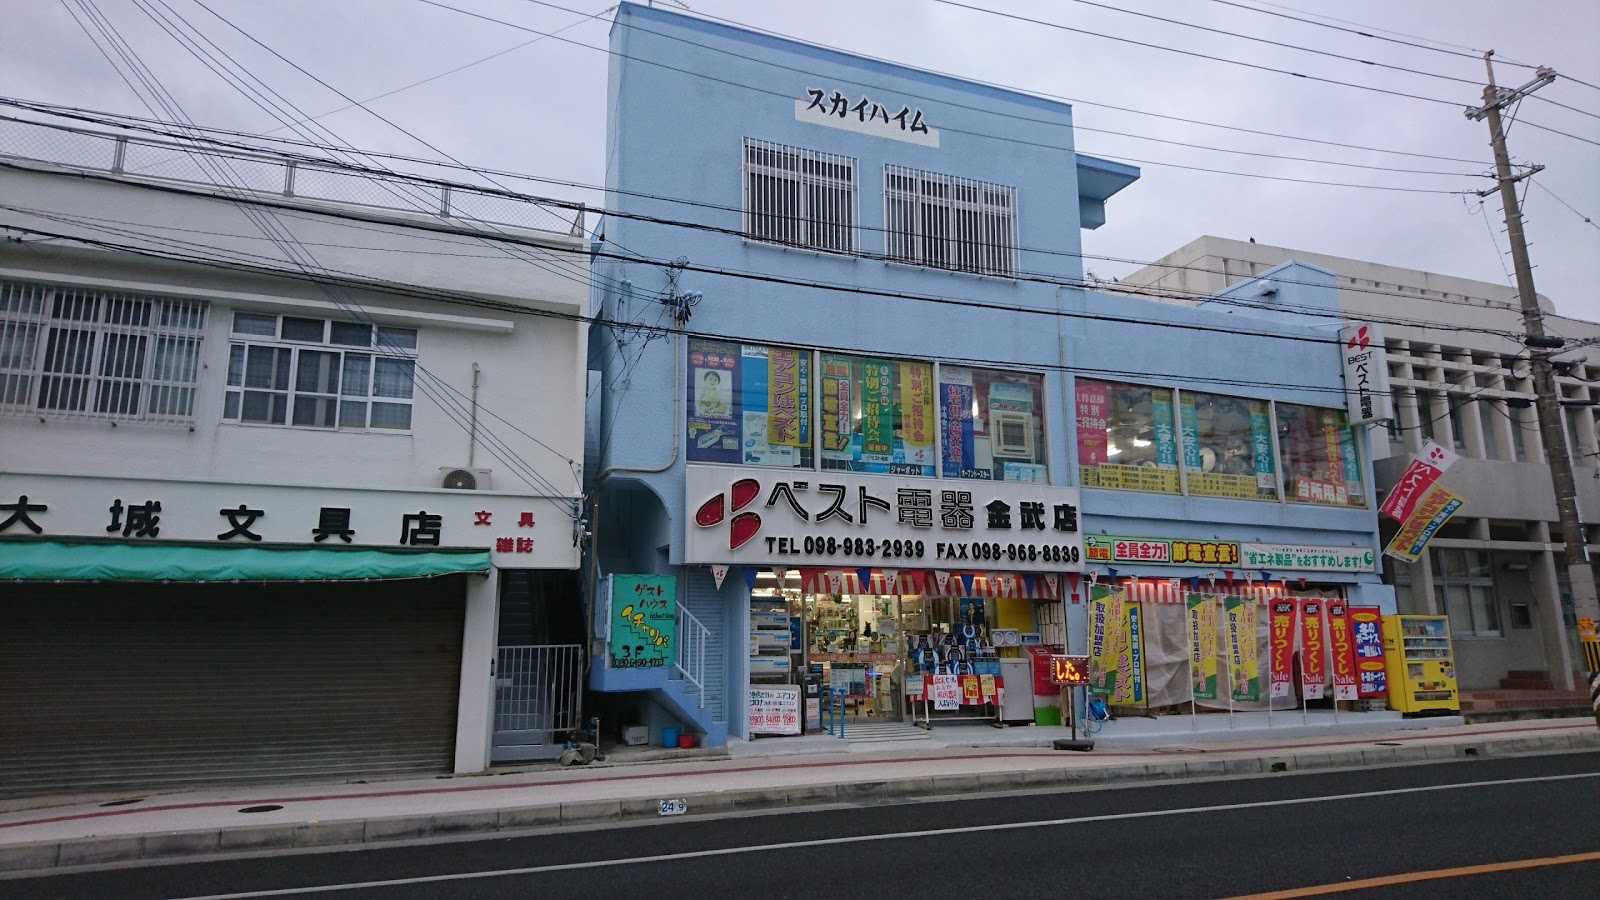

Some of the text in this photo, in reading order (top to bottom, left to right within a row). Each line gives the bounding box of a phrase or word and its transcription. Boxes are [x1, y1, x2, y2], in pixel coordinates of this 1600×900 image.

[806, 88, 928, 135] スカイハイム
[764, 481, 1078, 532] ベスト電器 金武店
[765, 536, 1080, 563] TEL 098-983-2939 FAX 098-968-8839
[1116, 542, 1167, 560] 全員全力!
[1273, 615, 1290, 672] 売りつくし
[1305, 616, 1321, 673] 売りつくし
[1332, 617, 1349, 674] 売りつくし
[1056, 660, 1081, 680] した。
